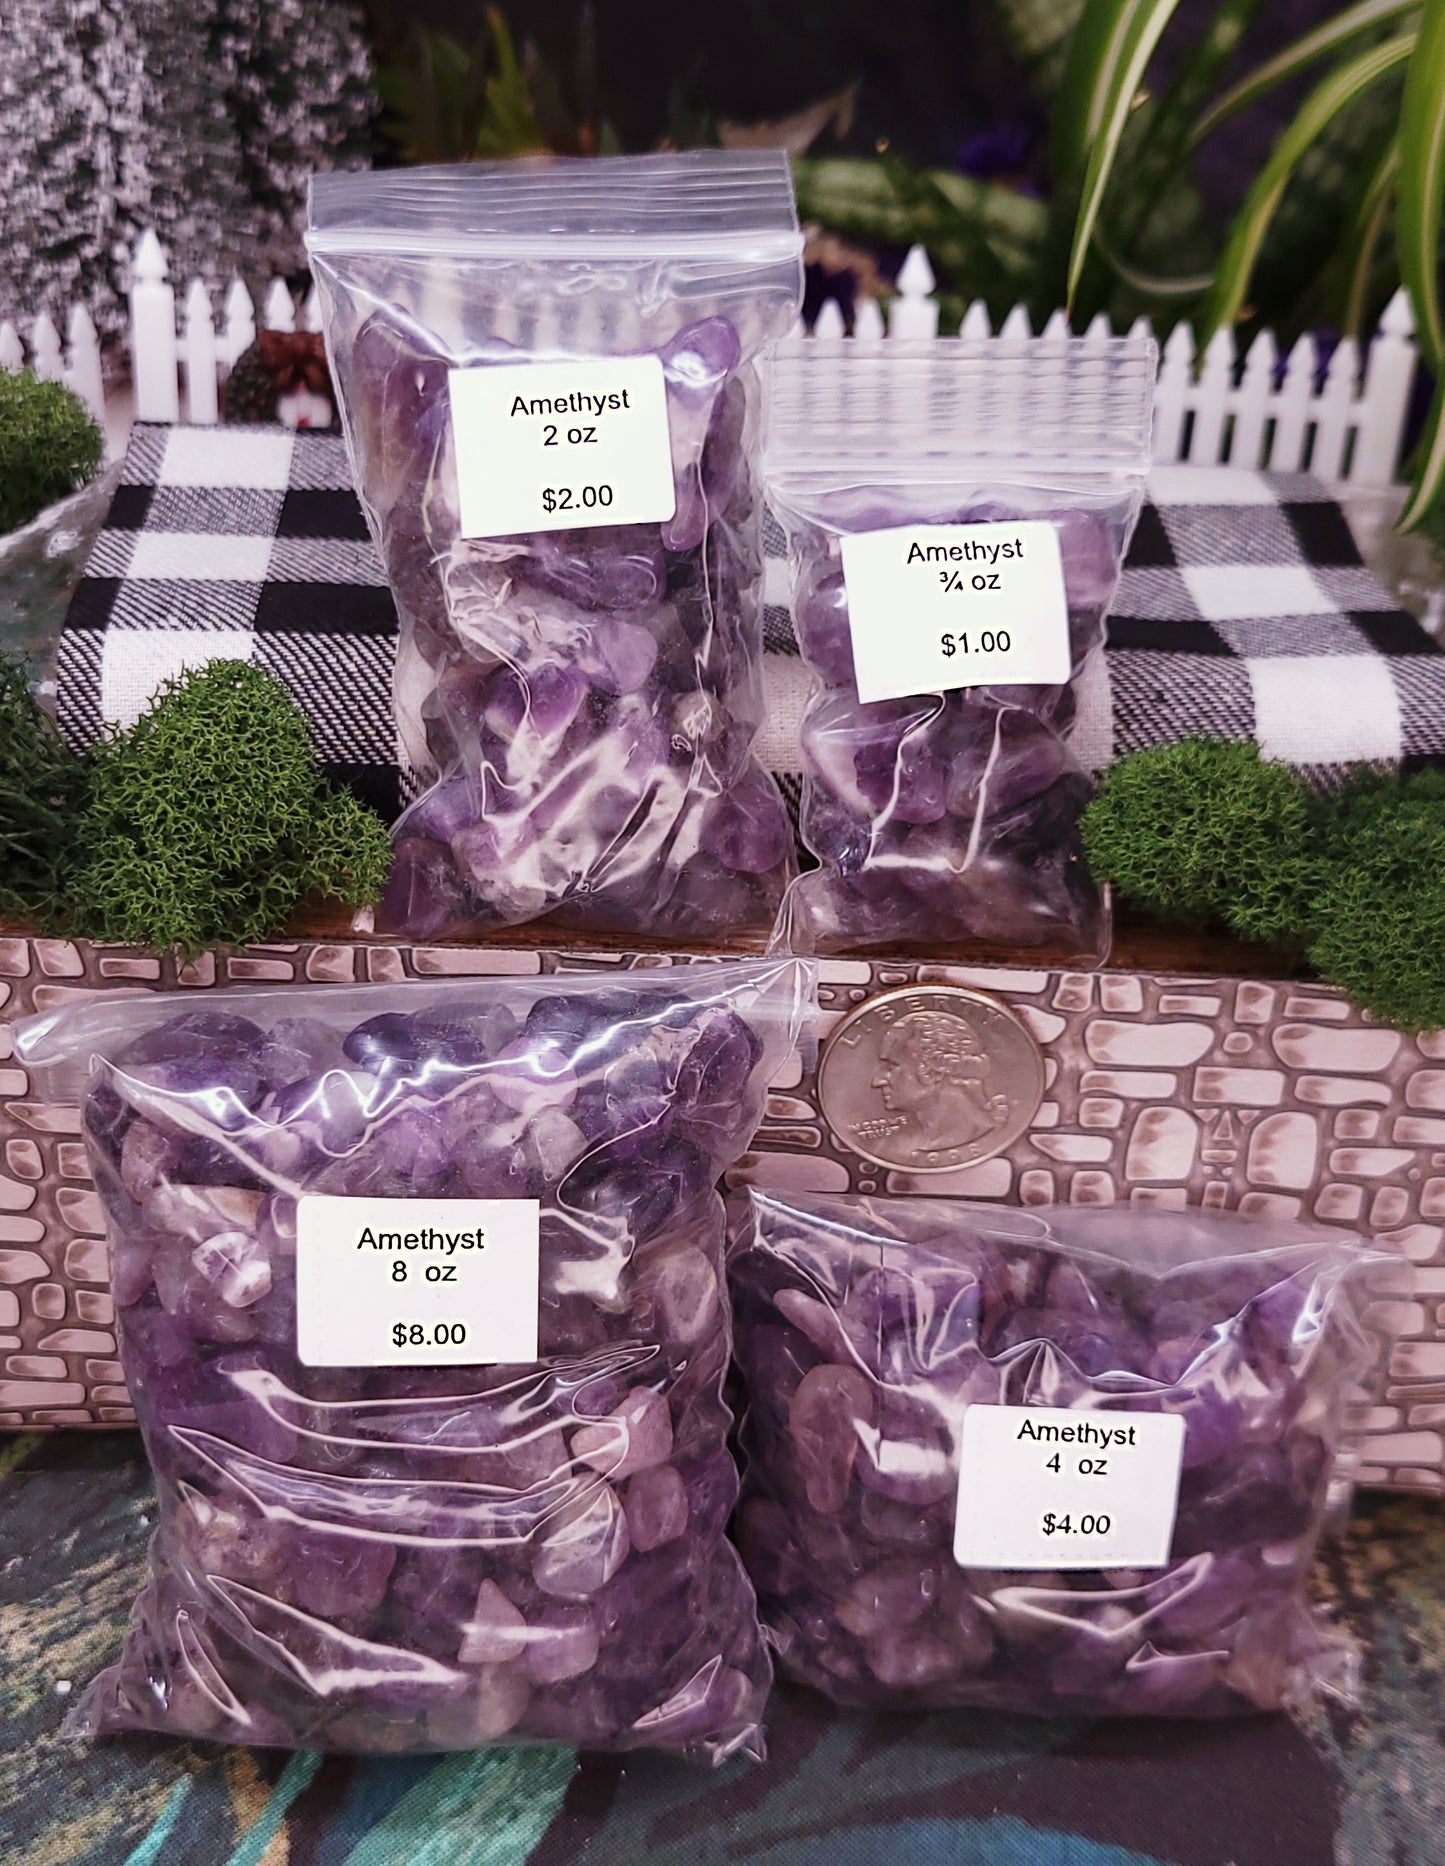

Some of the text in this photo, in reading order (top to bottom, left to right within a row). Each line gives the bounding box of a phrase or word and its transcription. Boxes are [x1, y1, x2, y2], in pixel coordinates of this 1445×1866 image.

[510, 389, 630, 417] Amethyst
[543, 424, 598, 447] 2 oz
[542, 484, 613, 514] $2.00
[907, 538, 1024, 565] Amethyst
[971, 573, 1002, 591] oz
[941, 630, 1011, 658] $1.00
[839, 996, 1006, 1047] LIBERTY
[356, 1227, 485, 1256] Amethyst
[391, 1260, 458, 1283] 8 oz
[392, 1322, 466, 1348] $8.00
[1016, 1419, 1138, 1450] Amethyst
[1045, 1452, 1108, 1477] 4 oz
[1042, 1513, 1111, 1537] $4.00
